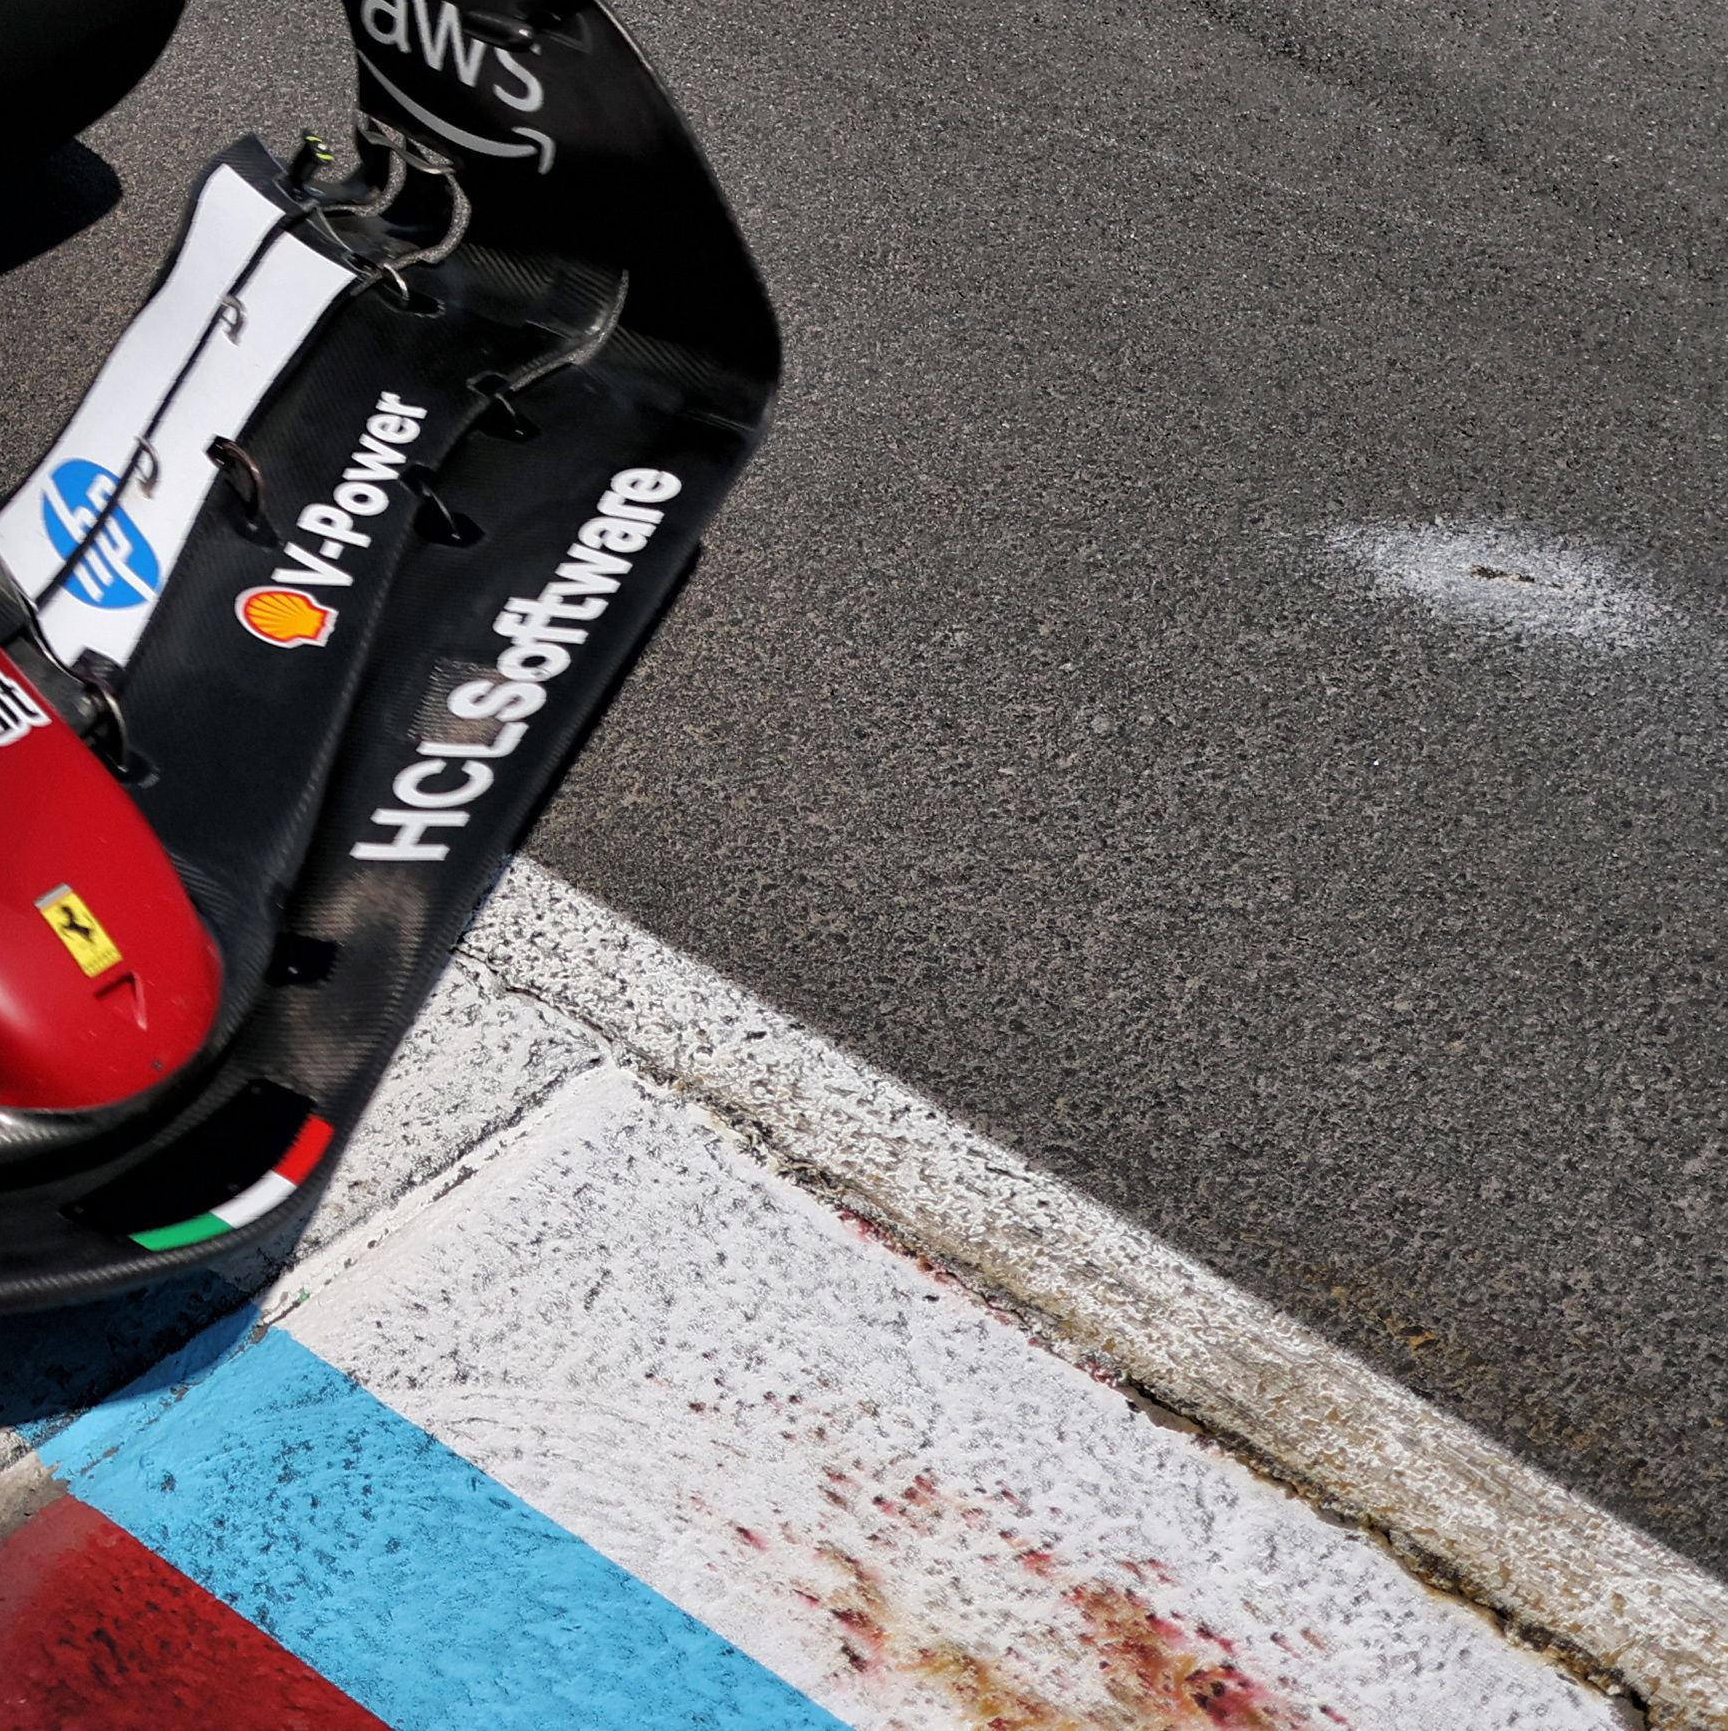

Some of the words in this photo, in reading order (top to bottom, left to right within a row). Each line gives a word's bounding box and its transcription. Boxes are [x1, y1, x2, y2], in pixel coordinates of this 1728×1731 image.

[43, 470, 157, 607] hp
[271, 390, 429, 588] V-Power
[349, 466, 684, 862] HCLSoftware
